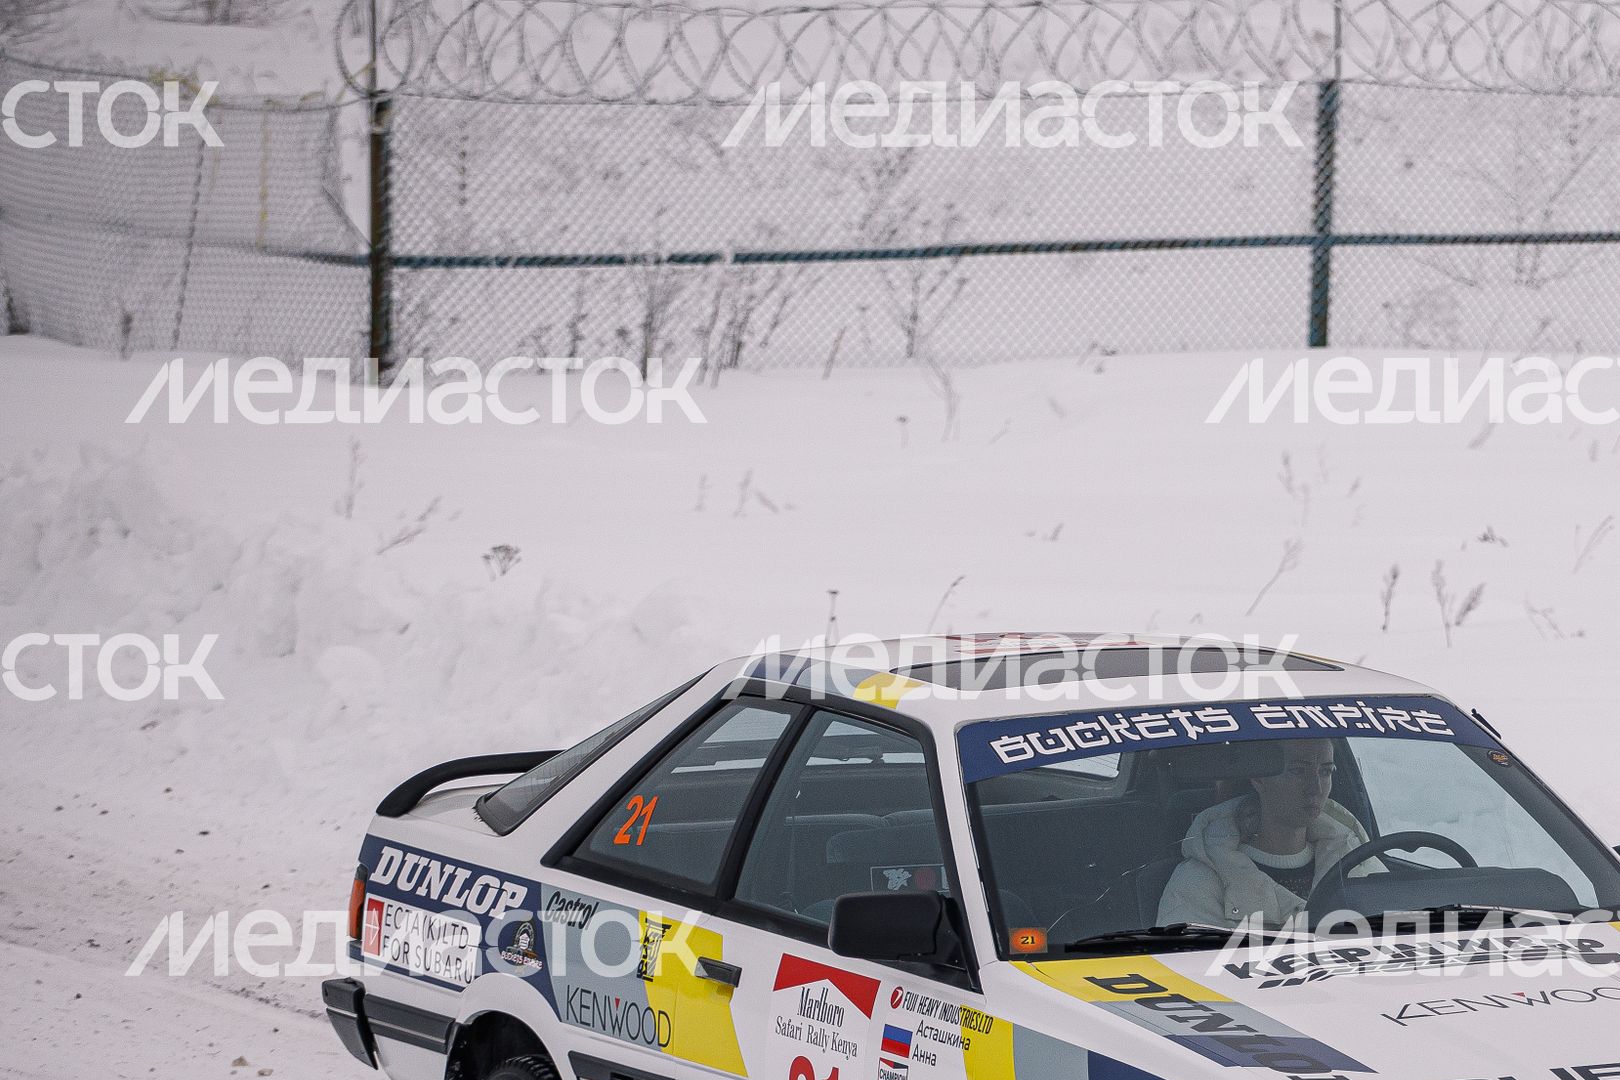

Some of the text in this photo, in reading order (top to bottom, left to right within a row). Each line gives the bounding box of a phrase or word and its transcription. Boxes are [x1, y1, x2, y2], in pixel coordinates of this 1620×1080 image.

[614, 795, 658, 846] 21
[369, 846, 528, 919] DUNLOP
[545, 890, 599, 931] Castrol
[382, 935, 474, 985] FOR SUBARU
[1019, 935, 1036, 945] 21
[1222, 945, 1371, 979] KEEP
[566, 985, 672, 1048] KENWOOD
[797, 987, 845, 1028] Marlboro
[902, 991, 920, 1013] FUJI
[917, 995, 942, 1018] HEAVY
[775, 1016, 858, 1061] Safari Rally Kenya
[911, 1043, 937, 1067] Анна
[915, 1019, 971, 1051] Асташкина
